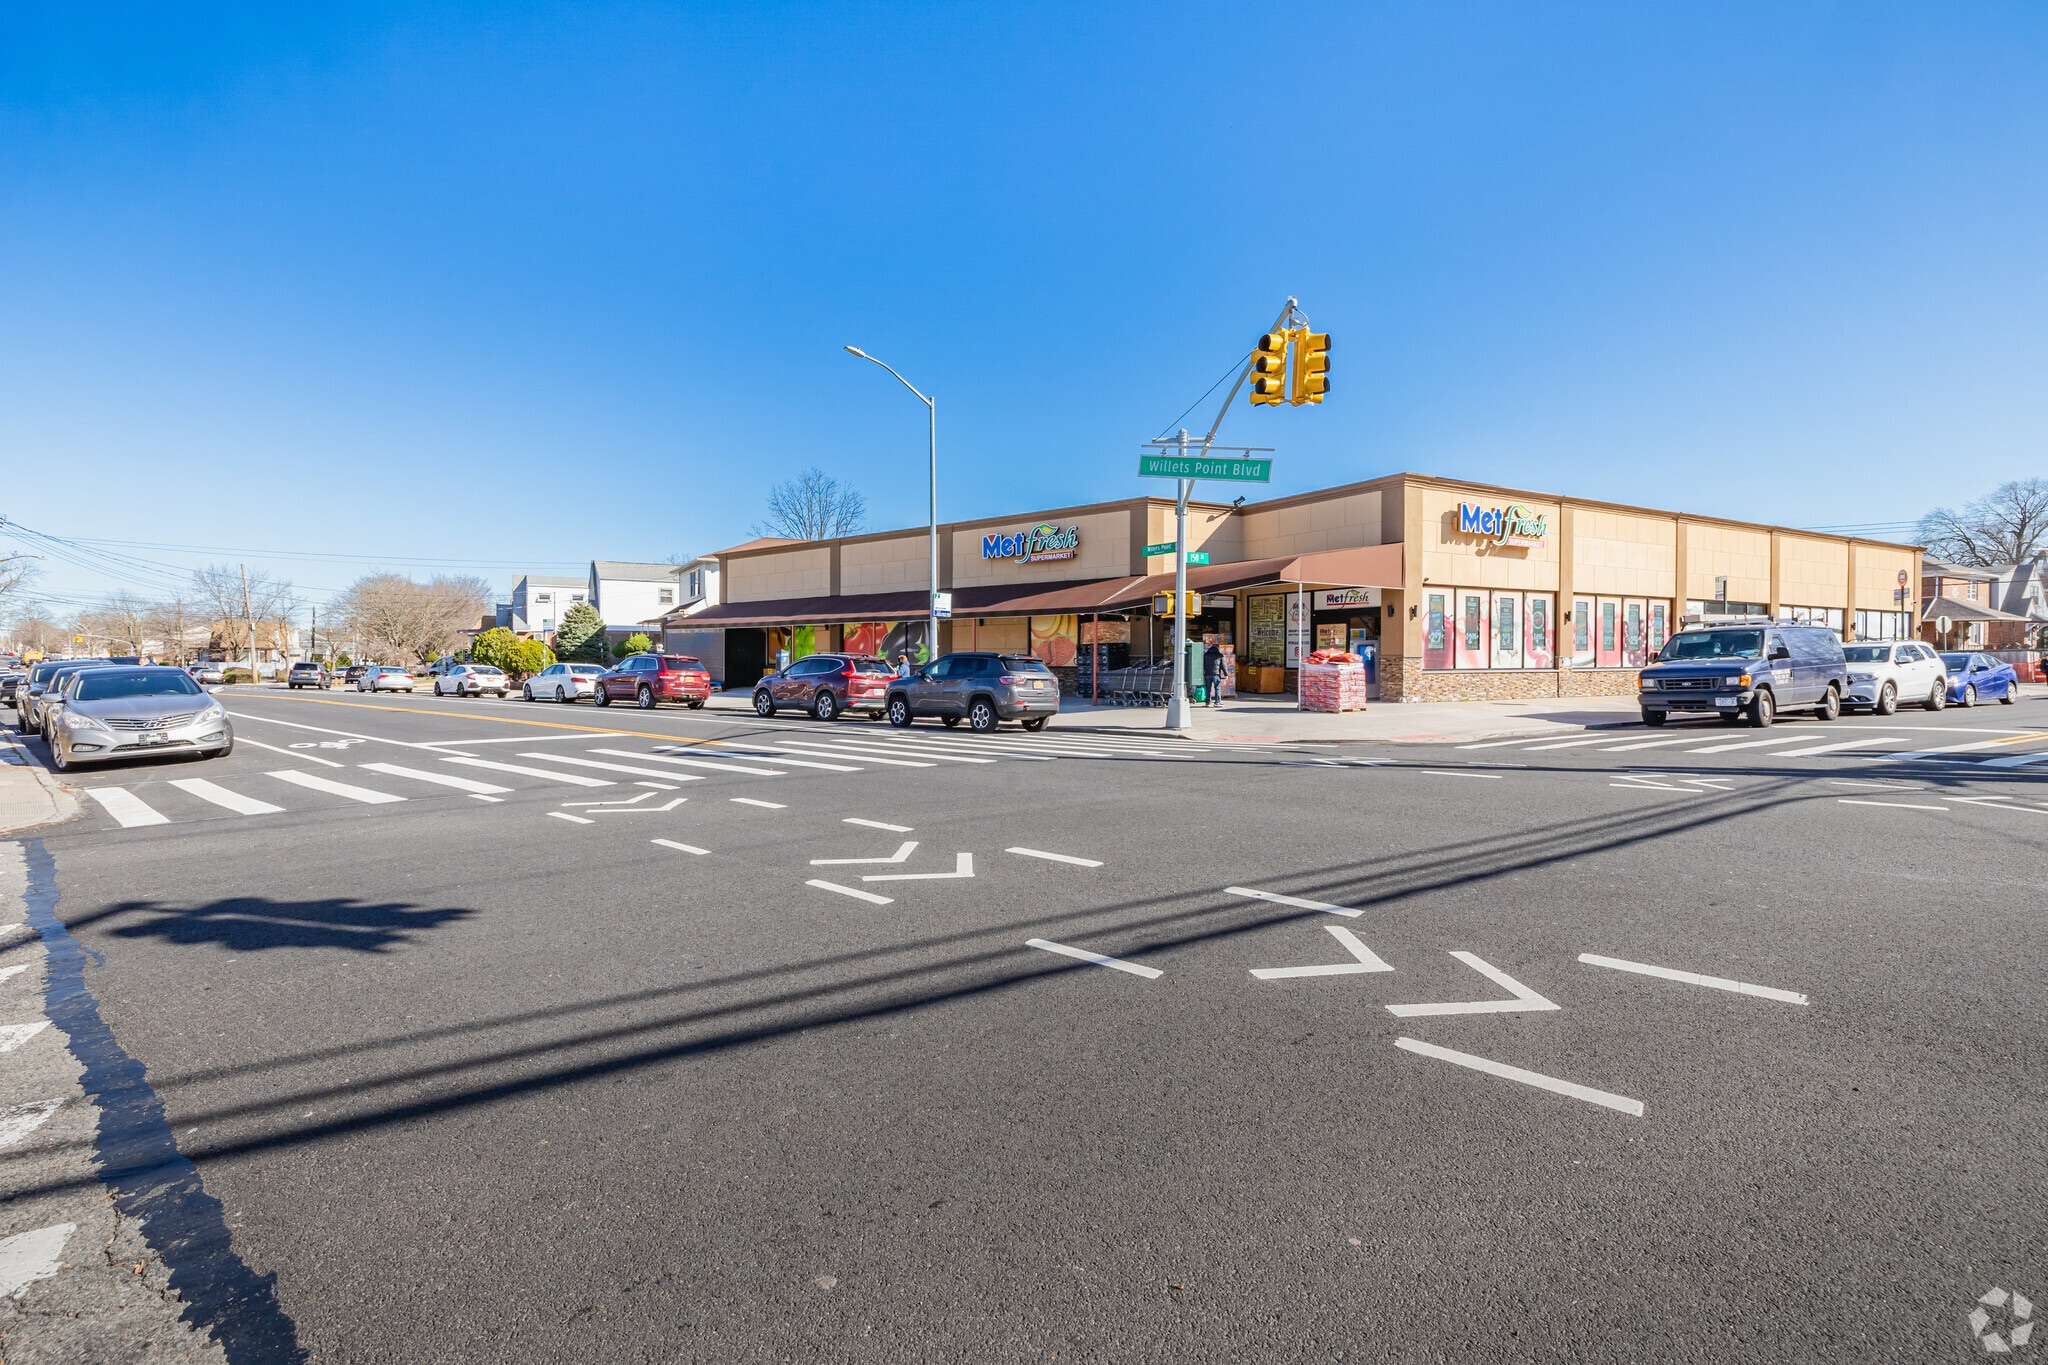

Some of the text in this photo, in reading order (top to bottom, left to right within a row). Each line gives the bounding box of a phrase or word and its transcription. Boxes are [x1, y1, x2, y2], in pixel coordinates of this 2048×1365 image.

[1149, 460, 1261, 476] Willets Point Blvd
[1031, 552, 1070, 561] SUPERMARKET
[1190, 553, 1200, 562] 150
[1257, 627, 1279, 637] Welcome
